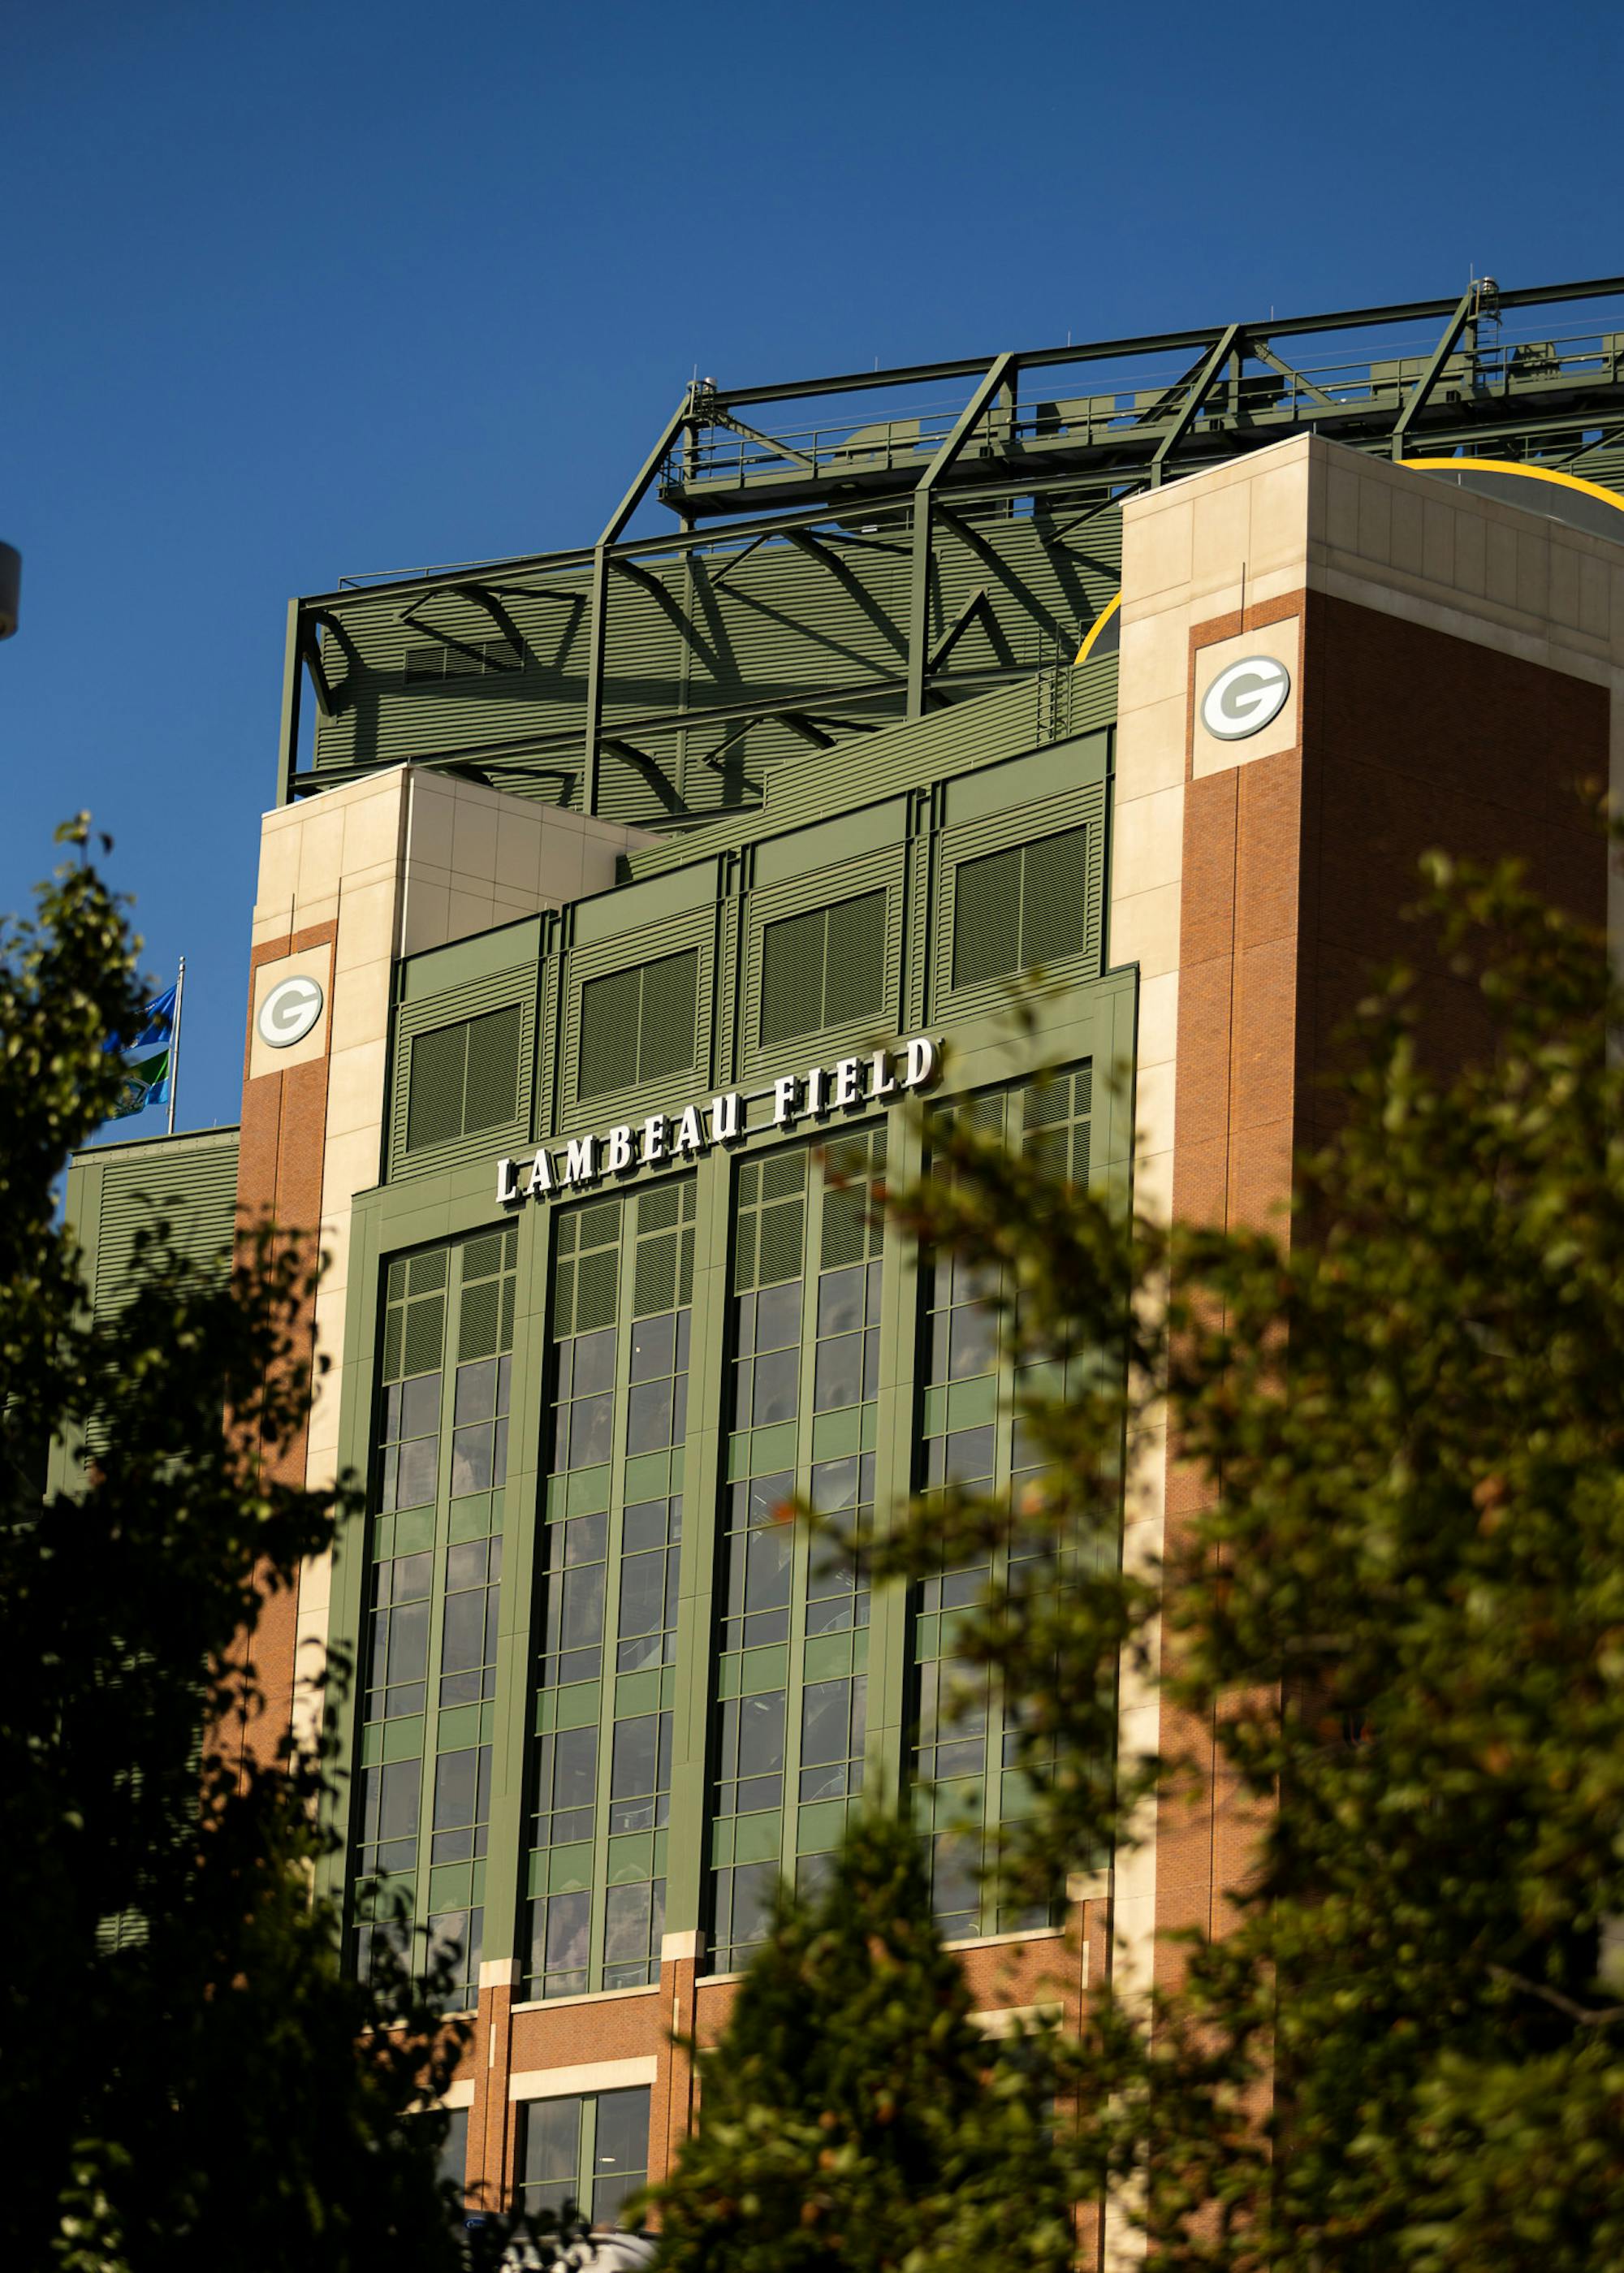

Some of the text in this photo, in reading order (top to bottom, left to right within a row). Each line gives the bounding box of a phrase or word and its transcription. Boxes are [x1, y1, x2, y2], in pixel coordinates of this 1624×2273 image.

[1203, 659, 1285, 735] G
[259, 979, 320, 1043] G
[496, 1038, 935, 1203] LAMBEAU FIELD
